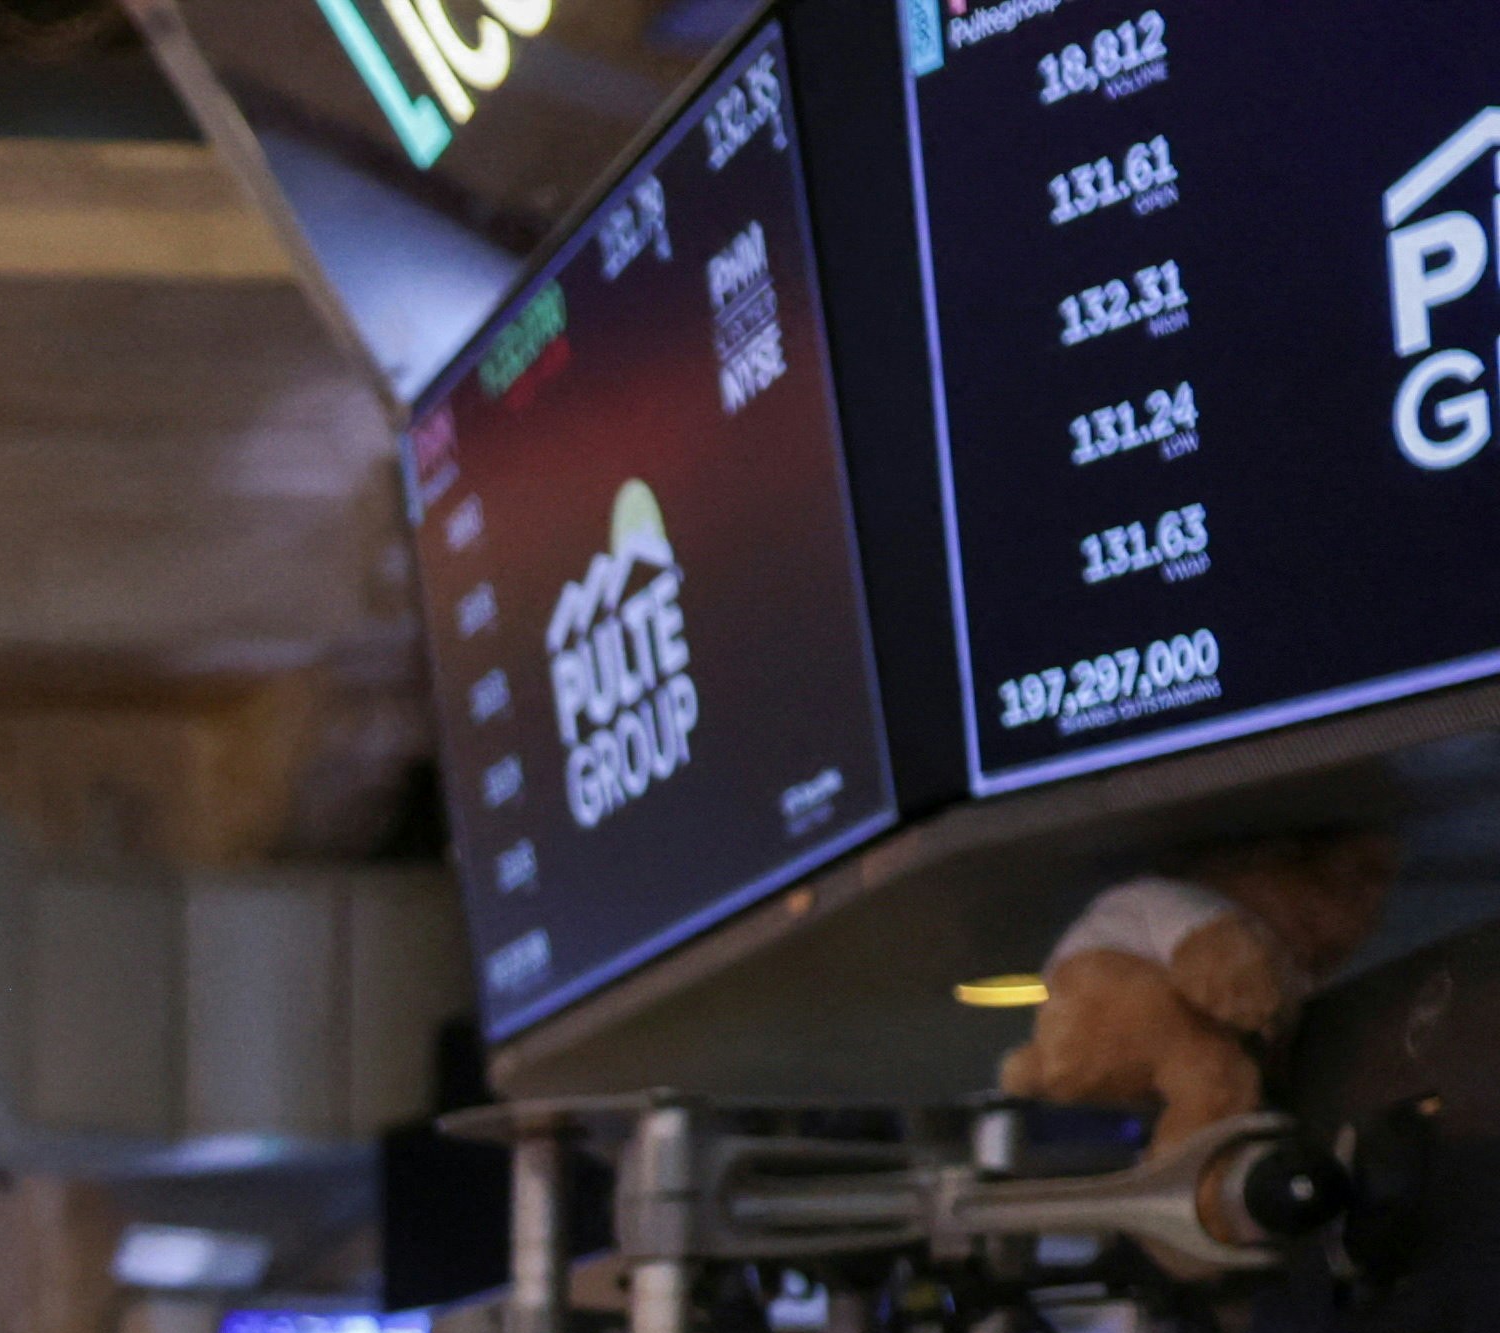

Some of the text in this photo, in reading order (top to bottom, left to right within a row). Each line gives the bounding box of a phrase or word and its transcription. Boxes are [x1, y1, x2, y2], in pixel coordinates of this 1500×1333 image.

[1037, 9, 1168, 105] 18,812
[1048, 134, 1179, 225] 131.61
[1058, 259, 1189, 346] 132.31
[1069, 380, 1199, 465] 131.24
[1080, 502, 1209, 585] 131.63
[550, 571, 691, 746] PULTE
[998, 627, 1220, 730] 197,297,000
[566, 673, 700, 829] GROUP
